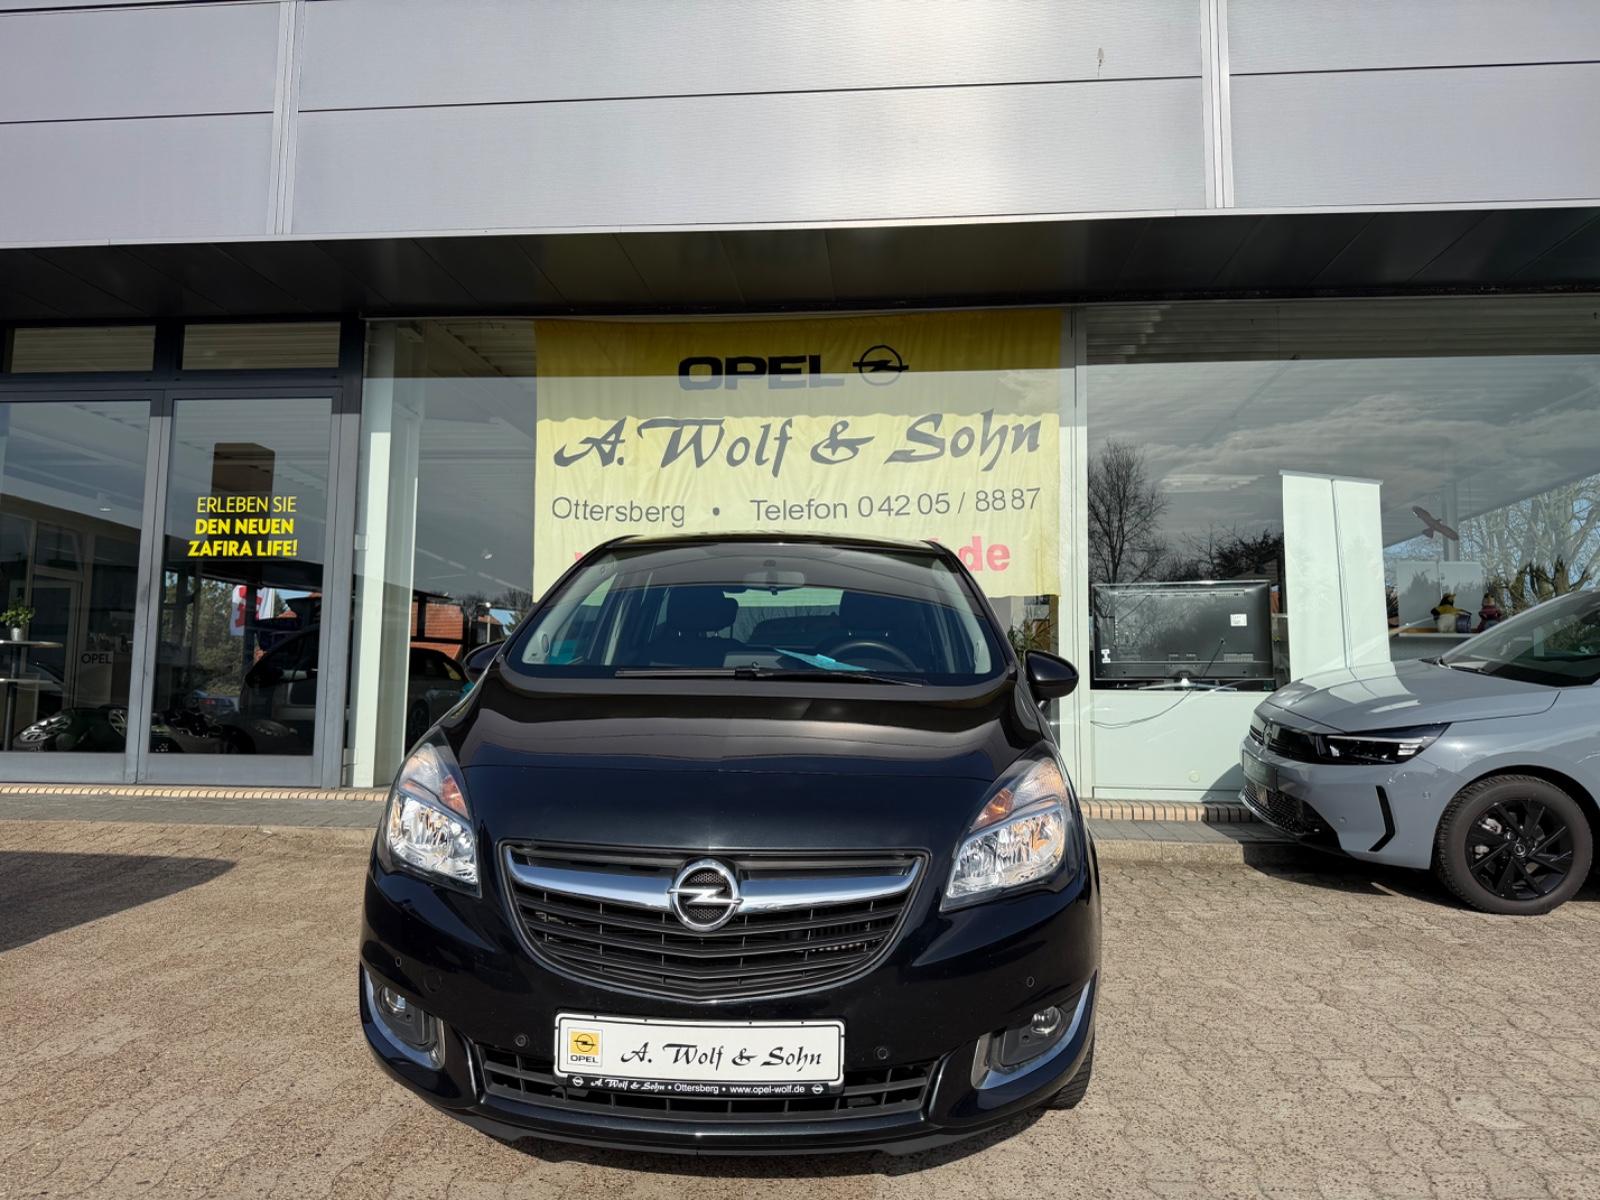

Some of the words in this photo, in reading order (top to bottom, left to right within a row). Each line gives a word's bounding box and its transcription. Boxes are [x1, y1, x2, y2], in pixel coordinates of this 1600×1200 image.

[678, 355, 846, 391] OPEL
[553, 415, 628, 468] A.
[636, 417, 793, 478] Wolf
[809, 419, 876, 465] &
[883, 407, 1042, 472] Sohn
[196, 495, 269, 513] ERLEBEN
[272, 495, 297, 513] SIE
[551, 496, 686, 528] Ottersberg
[749, 498, 848, 521] Telefon
[194, 518, 231, 535] DEN
[234, 518, 295, 535] NEUEN
[187, 540, 253, 557] ZAFIRA
[256, 538, 298, 557] LIFE!
[81, 653, 113, 664] OPEL
[570, 1054, 600, 1064] OPEL
[620, 1041, 653, 1063] A.
[662, 1043, 724, 1071] Wolf
[731, 1047, 758, 1067] &
[760, 1046, 822, 1072] Sohn
[604, 1079, 629, 1091] Wolf
[640, 1081, 666, 1093] Sohn
[673, 1082, 720, 1095] Ottersberg
[729, 1084, 806, 1096] www.opel-wolf.de
